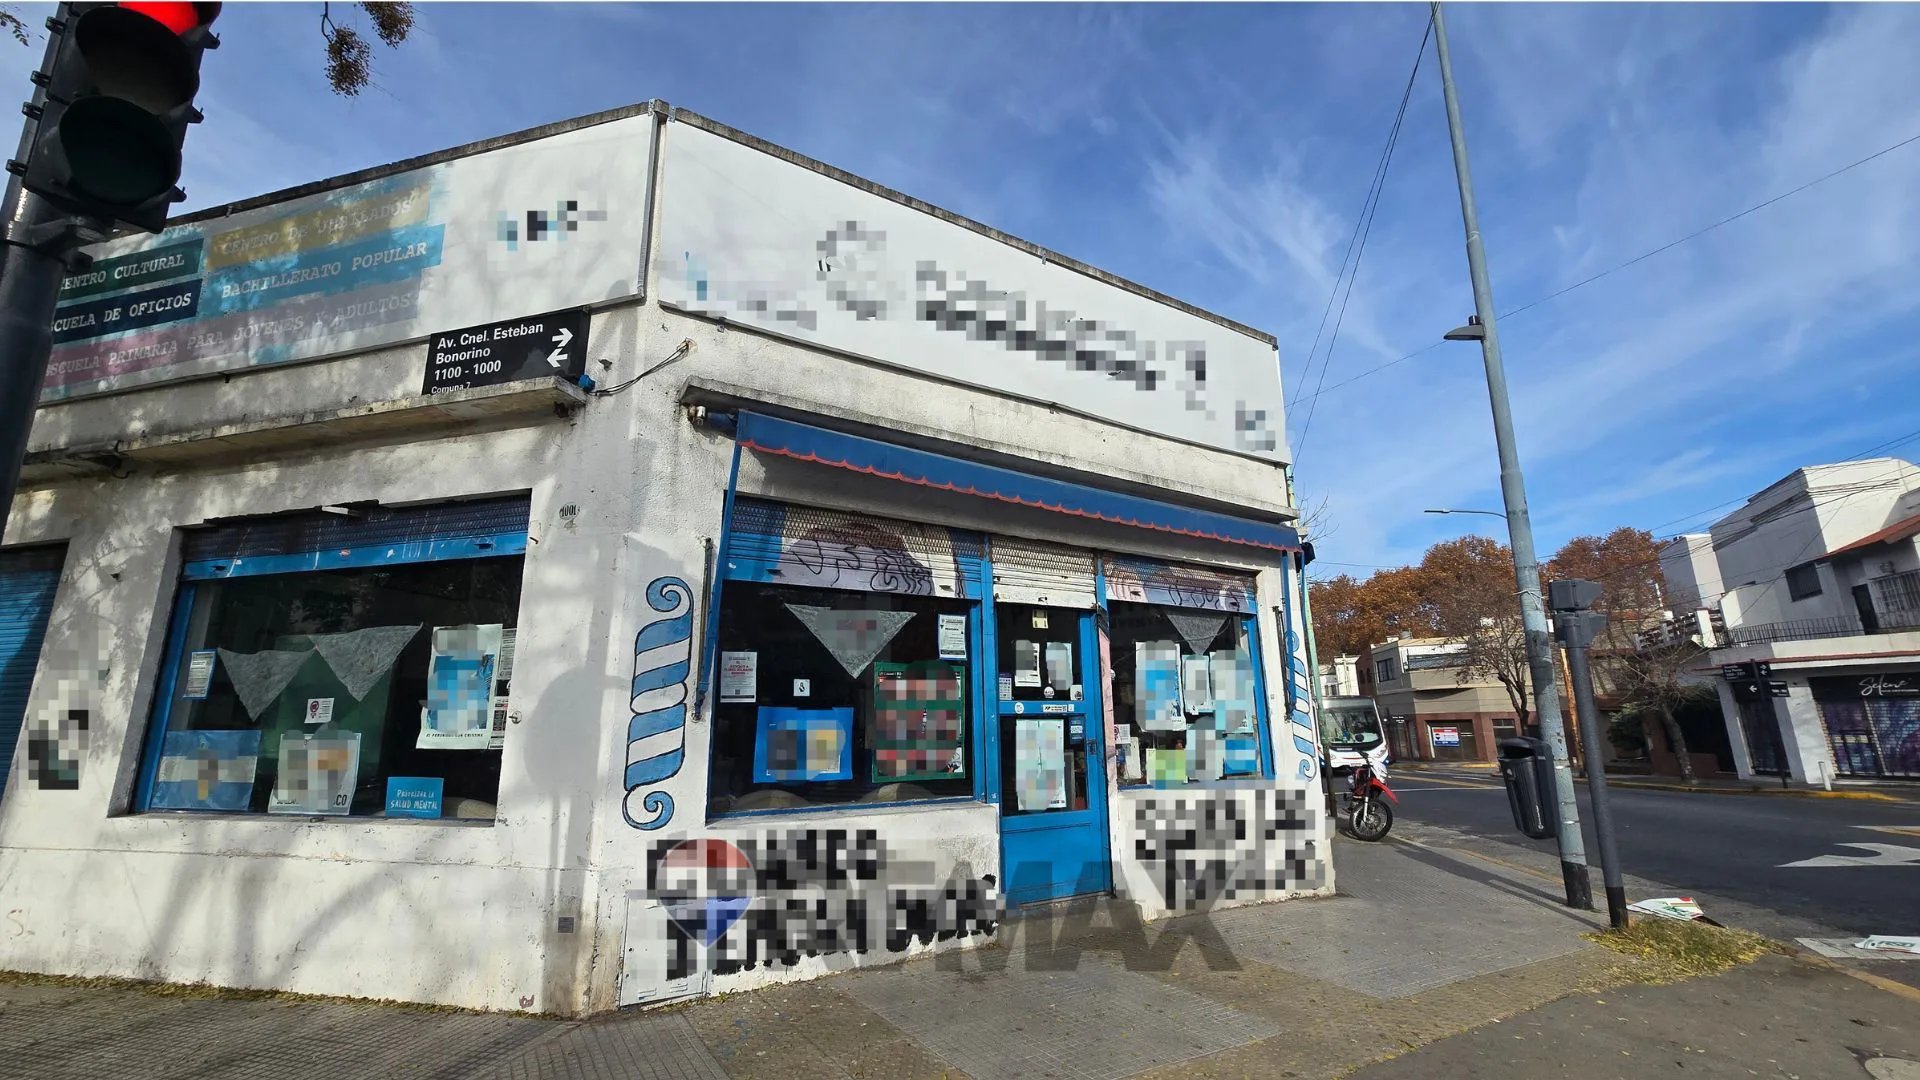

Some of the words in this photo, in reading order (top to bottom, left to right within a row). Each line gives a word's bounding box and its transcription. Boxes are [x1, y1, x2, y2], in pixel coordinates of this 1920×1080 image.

[221, 231, 279, 255] CENTRO
[288, 224, 307, 242] DE
[61, 270, 107, 289] ENTRO
[114, 254, 185, 280] CULTURAL
[222, 261, 342, 299] BACHILLERATO
[351, 242, 427, 271] POPULAR
[51, 313, 96, 332] CUELA
[103, 307, 122, 323] DE
[129, 293, 192, 318] OFICIOS
[108, 340, 177, 365] PRIMARIA
[187, 332, 224, 350] PARA
[234, 316, 304, 341] JÓVENES
[336, 294, 411, 321] ADULTOS
[437, 337, 457, 350] Av.
[460, 331, 490, 346] Cnel.
[493, 323, 543, 341] Esteban
[434, 366, 461, 381] 1100
[473, 360, 501, 375] 1000
[435, 347, 490, 365] Bonorino
[431, 385, 464, 394] Comuna
[390, 800, 411, 809] SALUD
[413, 799, 437, 809] MENTAL
